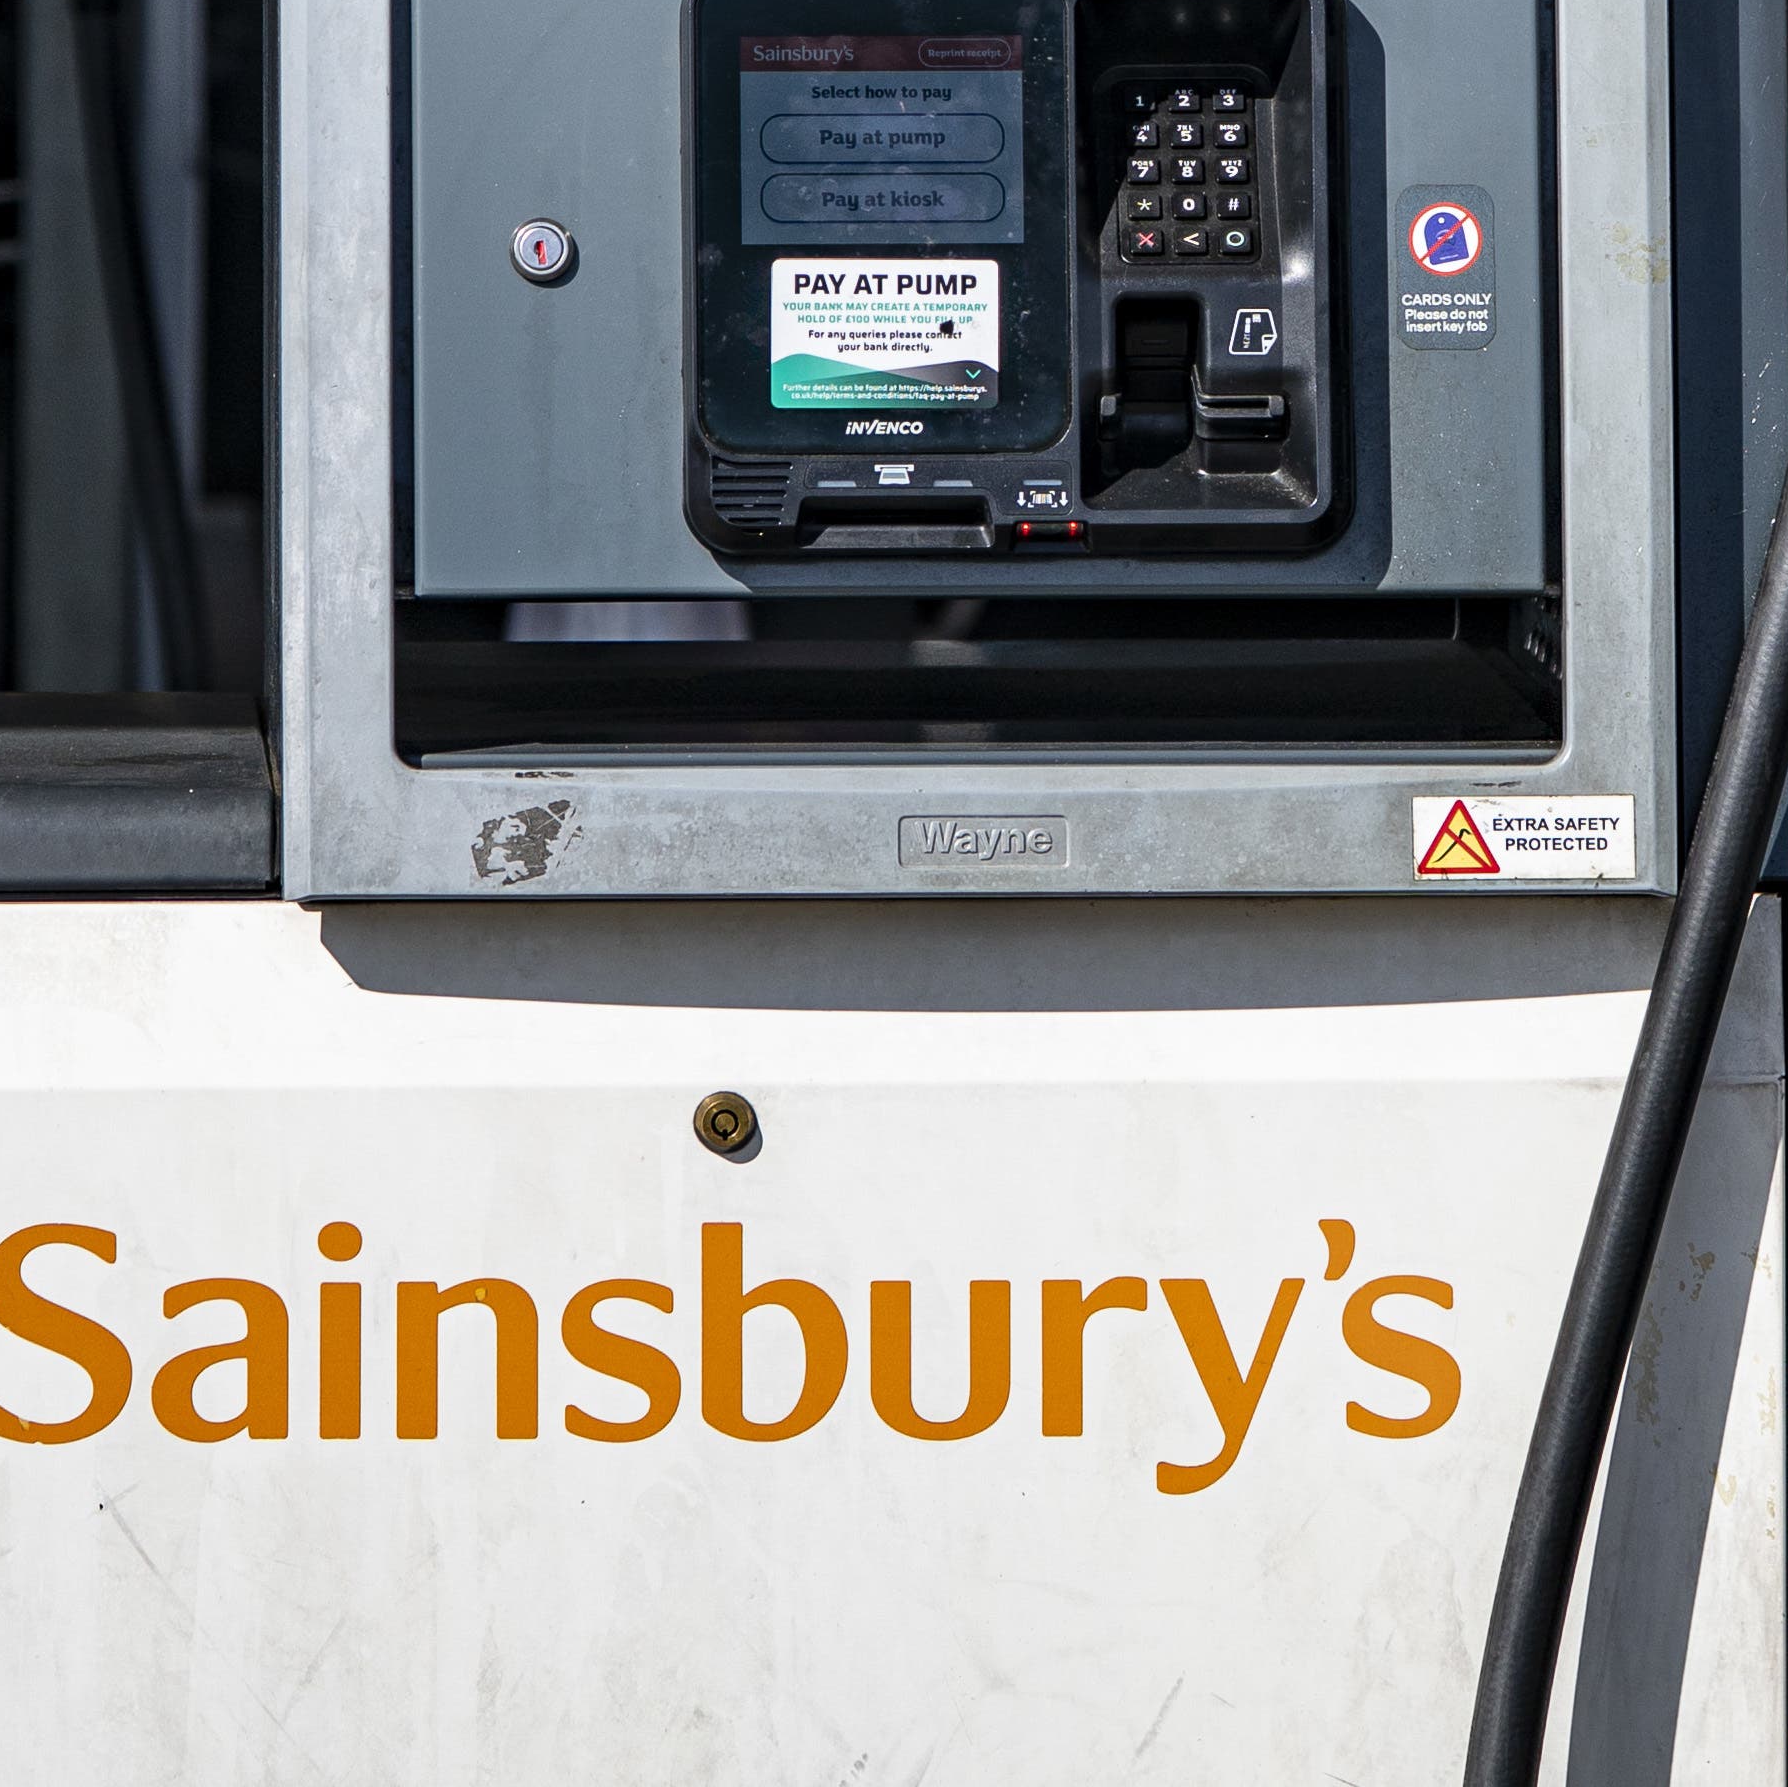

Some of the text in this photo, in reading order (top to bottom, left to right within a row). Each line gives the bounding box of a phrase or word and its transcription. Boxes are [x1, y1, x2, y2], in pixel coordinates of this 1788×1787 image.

[754, 45, 854, 64] Sainsbury's
[812, 86, 952, 101] Select how to pay
[820, 130, 945, 149] Pay at pump
[822, 191, 945, 211] Pay at kiosk
[794, 274, 977, 295] PAY AT PUMP
[783, 302, 987, 311] YOUR BANK MAY CREATE A TEMPORARY
[1401, 293, 1492, 305] CARDS ONLY
[1405, 309, 1488, 320] Please do not
[1406, 321, 1487, 334] insert key fob
[1492, 816, 1620, 833] EXTRA SAFETY
[919, 822, 1053, 857] Wayne
[1505, 837, 1608, 852] PROTECTED
